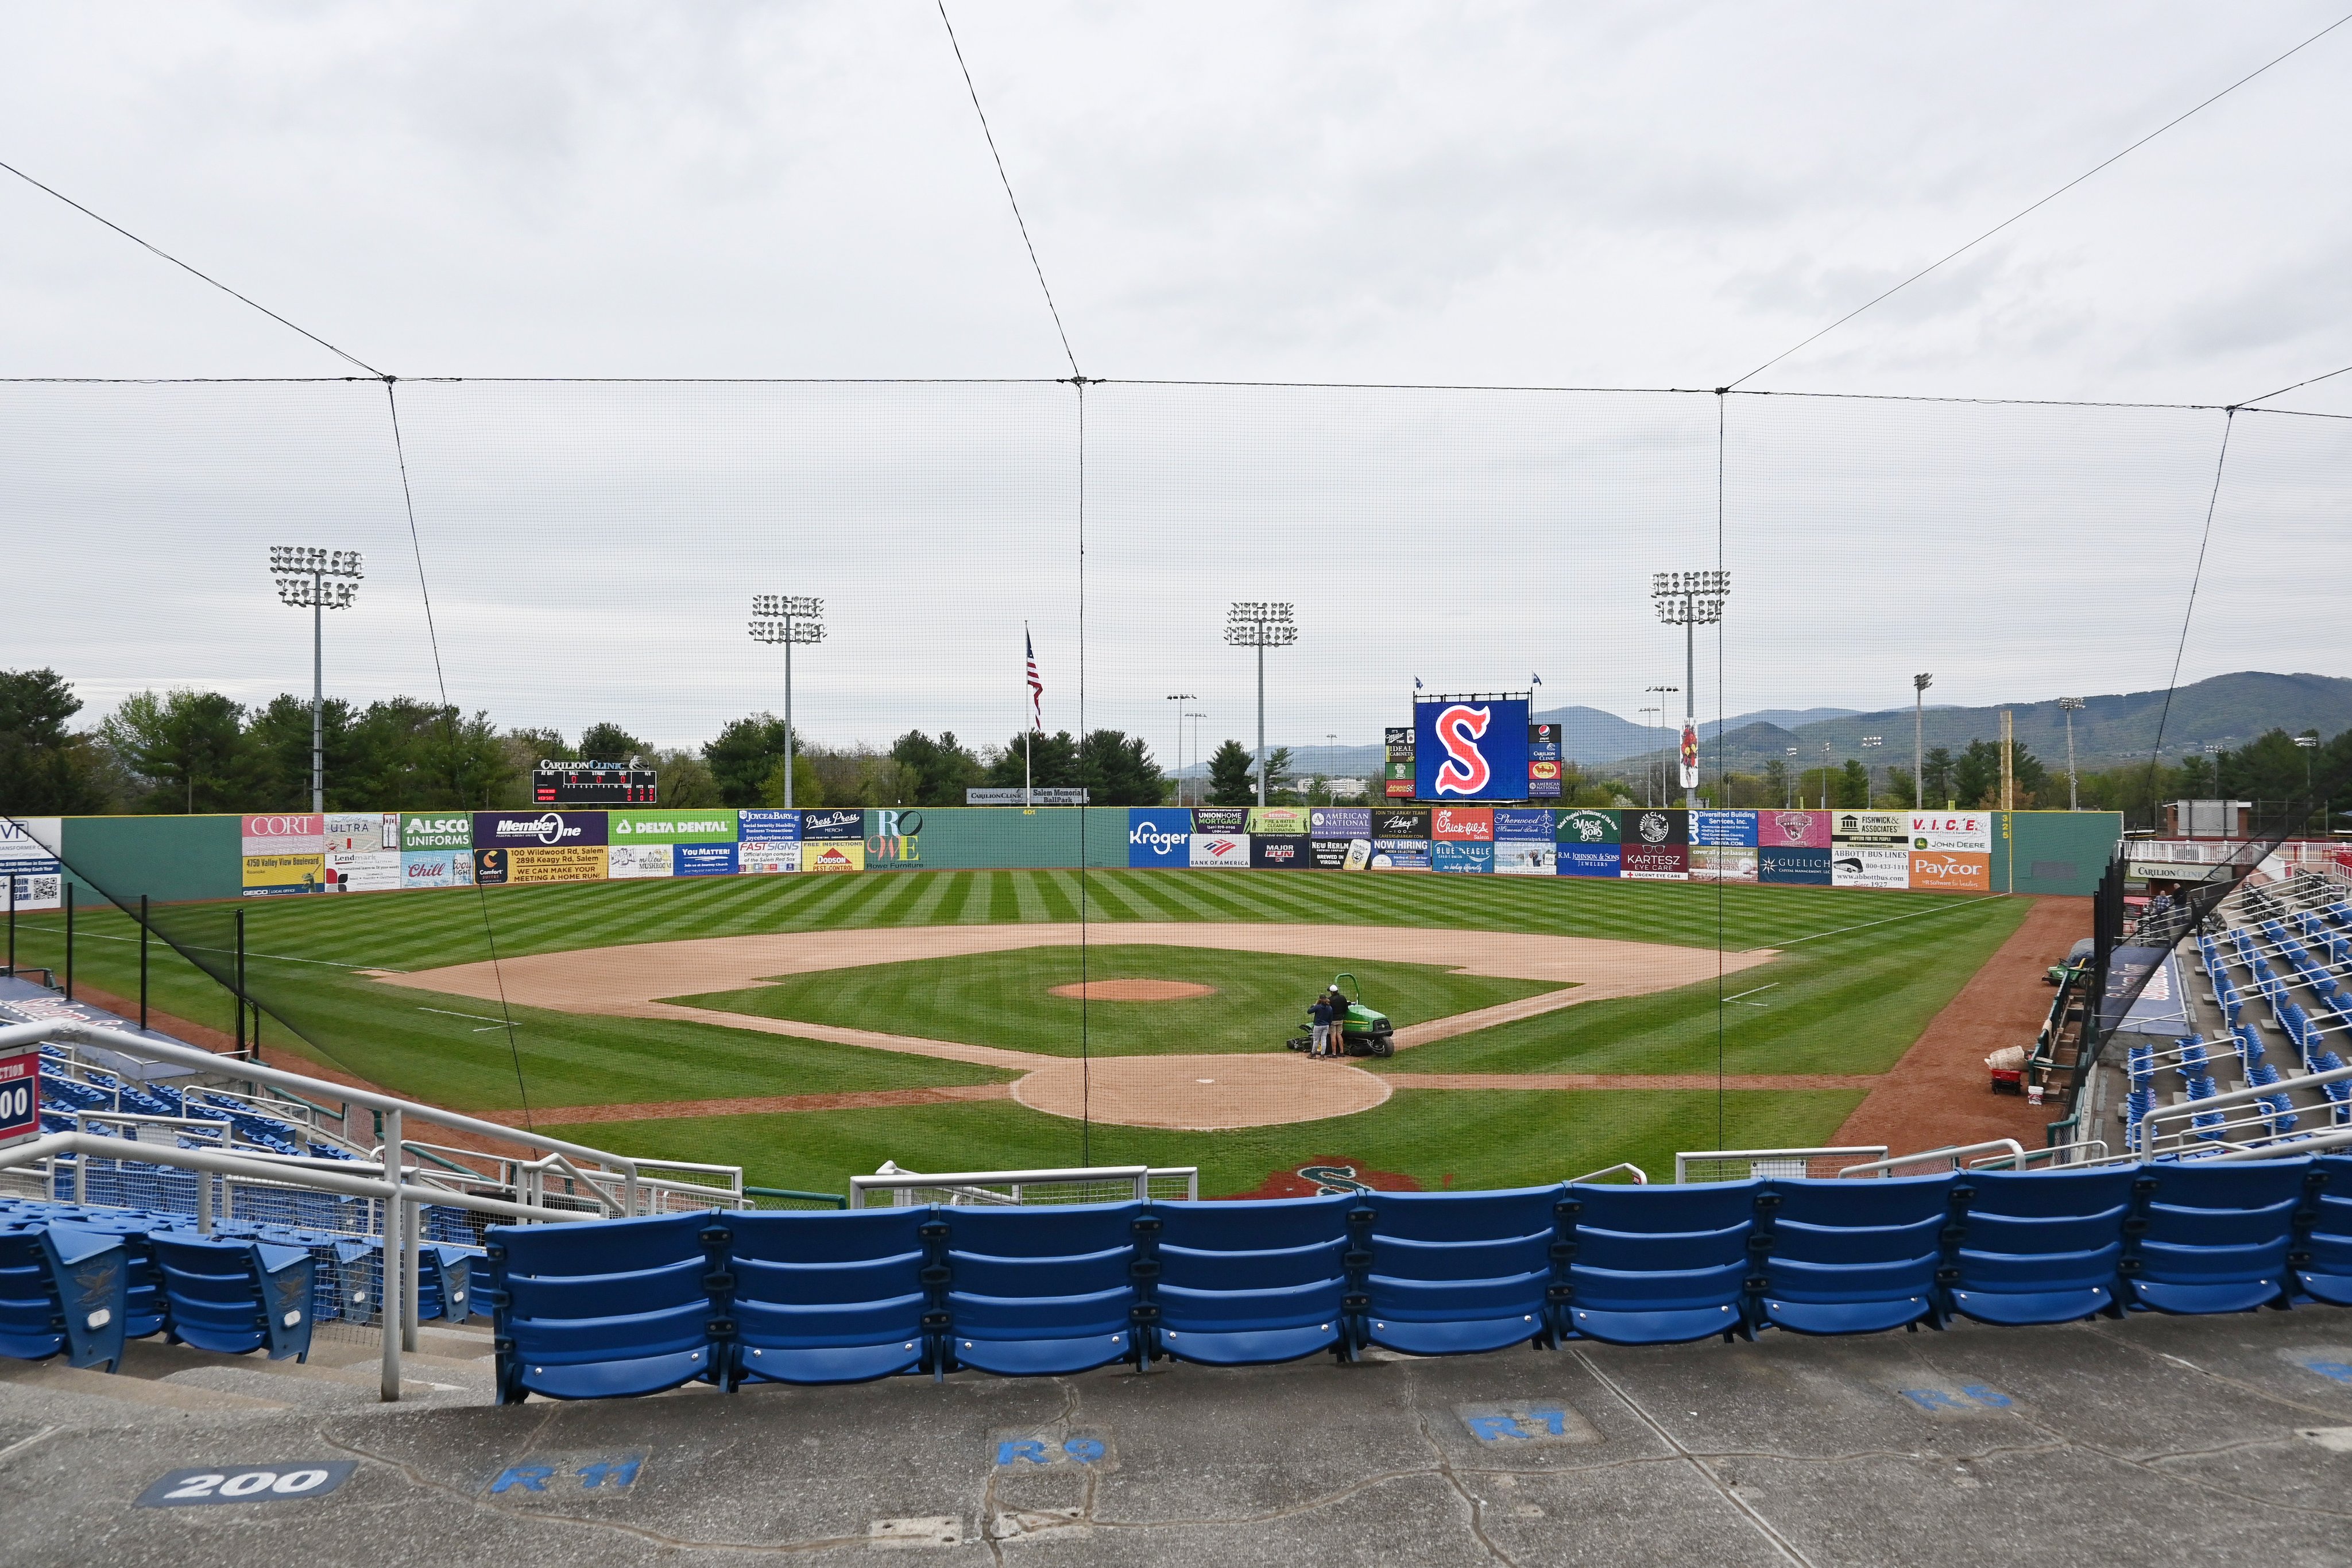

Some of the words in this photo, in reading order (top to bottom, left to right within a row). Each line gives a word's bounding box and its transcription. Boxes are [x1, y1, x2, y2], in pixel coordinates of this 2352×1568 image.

[1436, 704, 1491, 796] S
[541, 759, 590, 771] CARILION
[589, 760, 625, 770] CLINIC
[1436, 814, 1489, 834] Chick-fil-A
[1494, 813, 1541, 824] Sherwood
[1556, 818, 1568, 830] Voted
[1565, 810, 1582, 821] Virginia's
[1610, 820, 1618, 831] Year
[1639, 813, 1650, 831] WHITE
[1650, 811, 1667, 822] CLAW
[1862, 816, 1891, 824] FISHWICK
[251, 816, 313, 835] CORT
[331, 823, 369, 833] ULTRA
[404, 818, 469, 834] ALSCO
[497, 819, 557, 832] Member
[538, 812, 582, 845] One
[636, 822, 675, 834] DELTA
[677, 820, 729, 833] DENTAL
[1862, 825, 1897, 833] ASSOCIATES
[407, 835, 470, 846] UNIFORMS
[1129, 822, 1188, 855] Kroger
[740, 842, 800, 851] FASTSIGNS
[1327, 842, 1349, 850] REALM
[1374, 840, 1395, 850] NOW
[1396, 841, 1428, 850] HIRING
[537, 857, 560, 865] Keagy
[817, 855, 847, 864] DODSON
[1572, 852, 1598, 860] JOHNSON
[1627, 854, 1681, 865] KARTESZ
[247, 859, 260, 868] 4750
[262, 859, 278, 868] Valley
[279, 858, 292, 866] View
[293, 857, 319, 865] Boulevard
[1778, 858, 1831, 868] GUELICH
[1915, 859, 1982, 878] Paycor
[408, 863, 446, 878] Chill
[2138, 867, 2176, 877] CARILION
[2176, 869, 2206, 878] CLINIC
[1837, 874, 1904, 882] www.abbottbus.com
[1902, 1388, 1970, 1411] R
[1961, 1385, 2013, 1407] 5
[1468, 1416, 1531, 1441] R
[1529, 1411, 1566, 1435] 7
[997, 1440, 1051, 1466] R
[1063, 1438, 1105, 1464] 9
[490, 1465, 555, 1493] R
[577, 1461, 641, 1489] 11
[163, 1469, 329, 1499] 200
